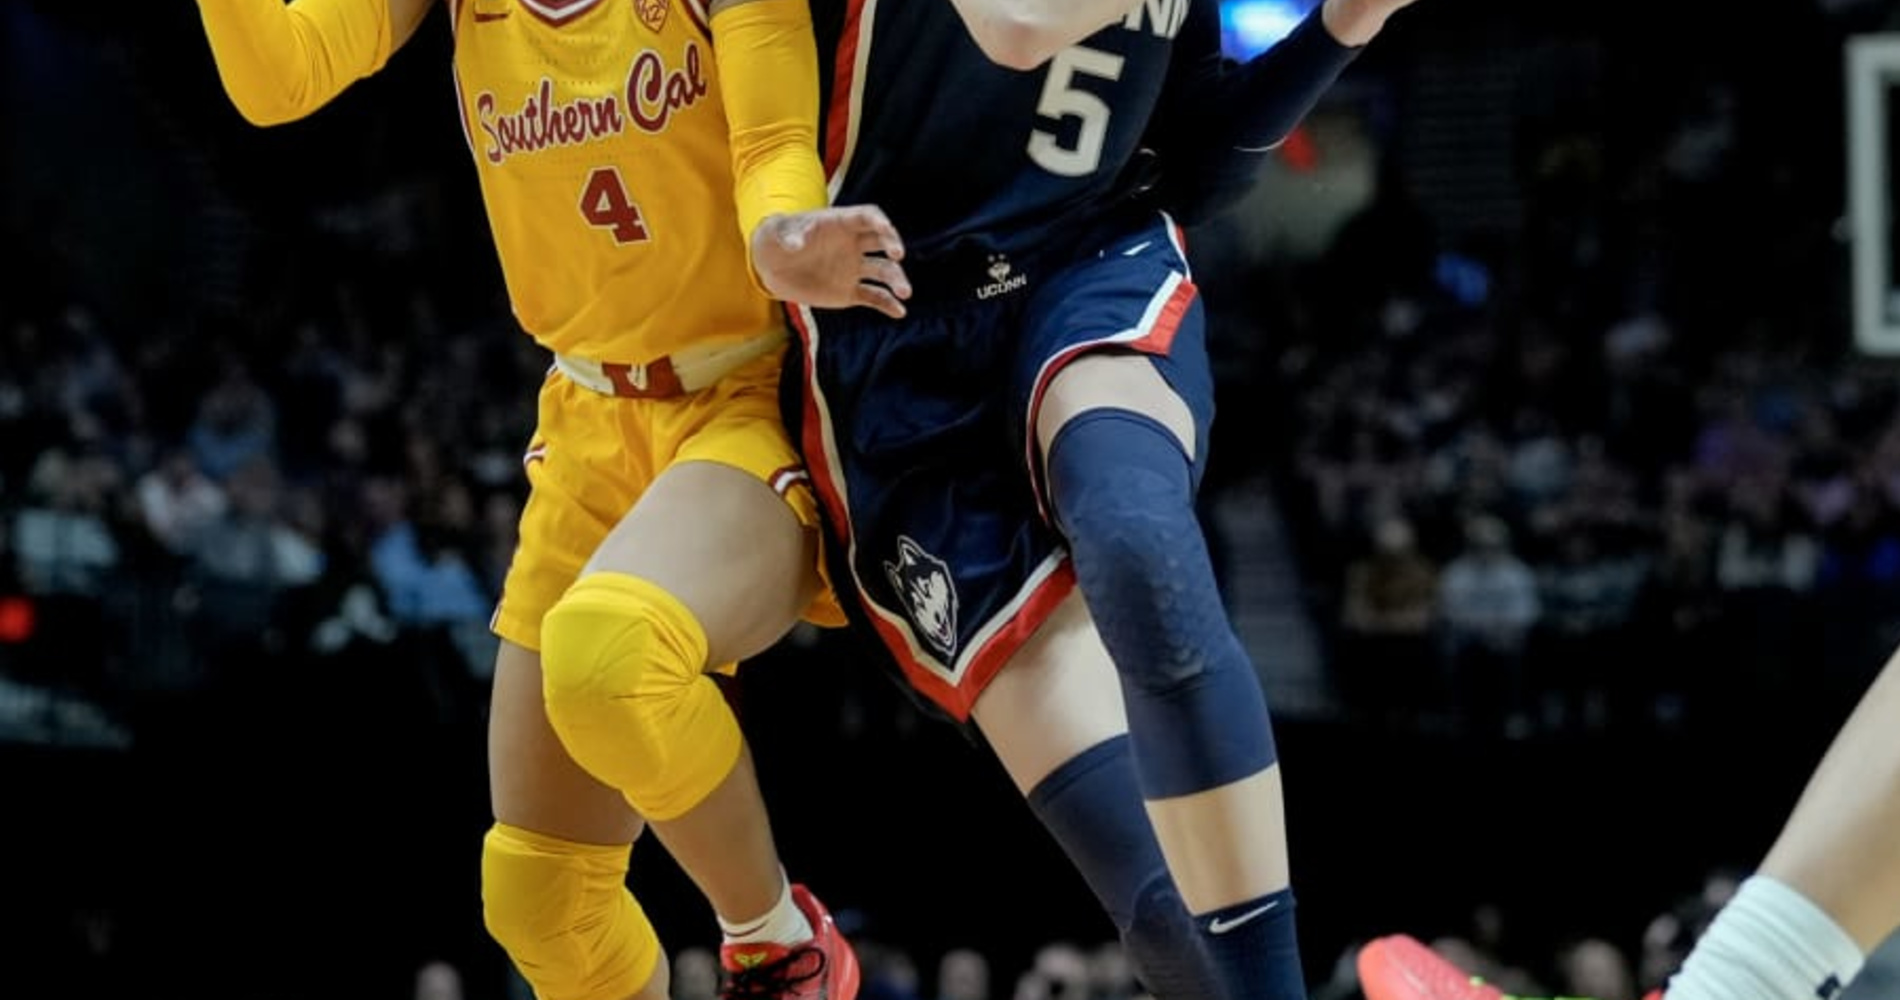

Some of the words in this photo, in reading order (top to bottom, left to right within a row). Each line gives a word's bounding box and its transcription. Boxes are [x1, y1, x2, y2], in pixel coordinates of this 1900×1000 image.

[476, 77, 622, 166] Southern
[626, 41, 708, 134] Cal
[1026, 43, 1125, 178] 5
[579, 165, 650, 246] 4
[976, 272, 1028, 300] UCONN
